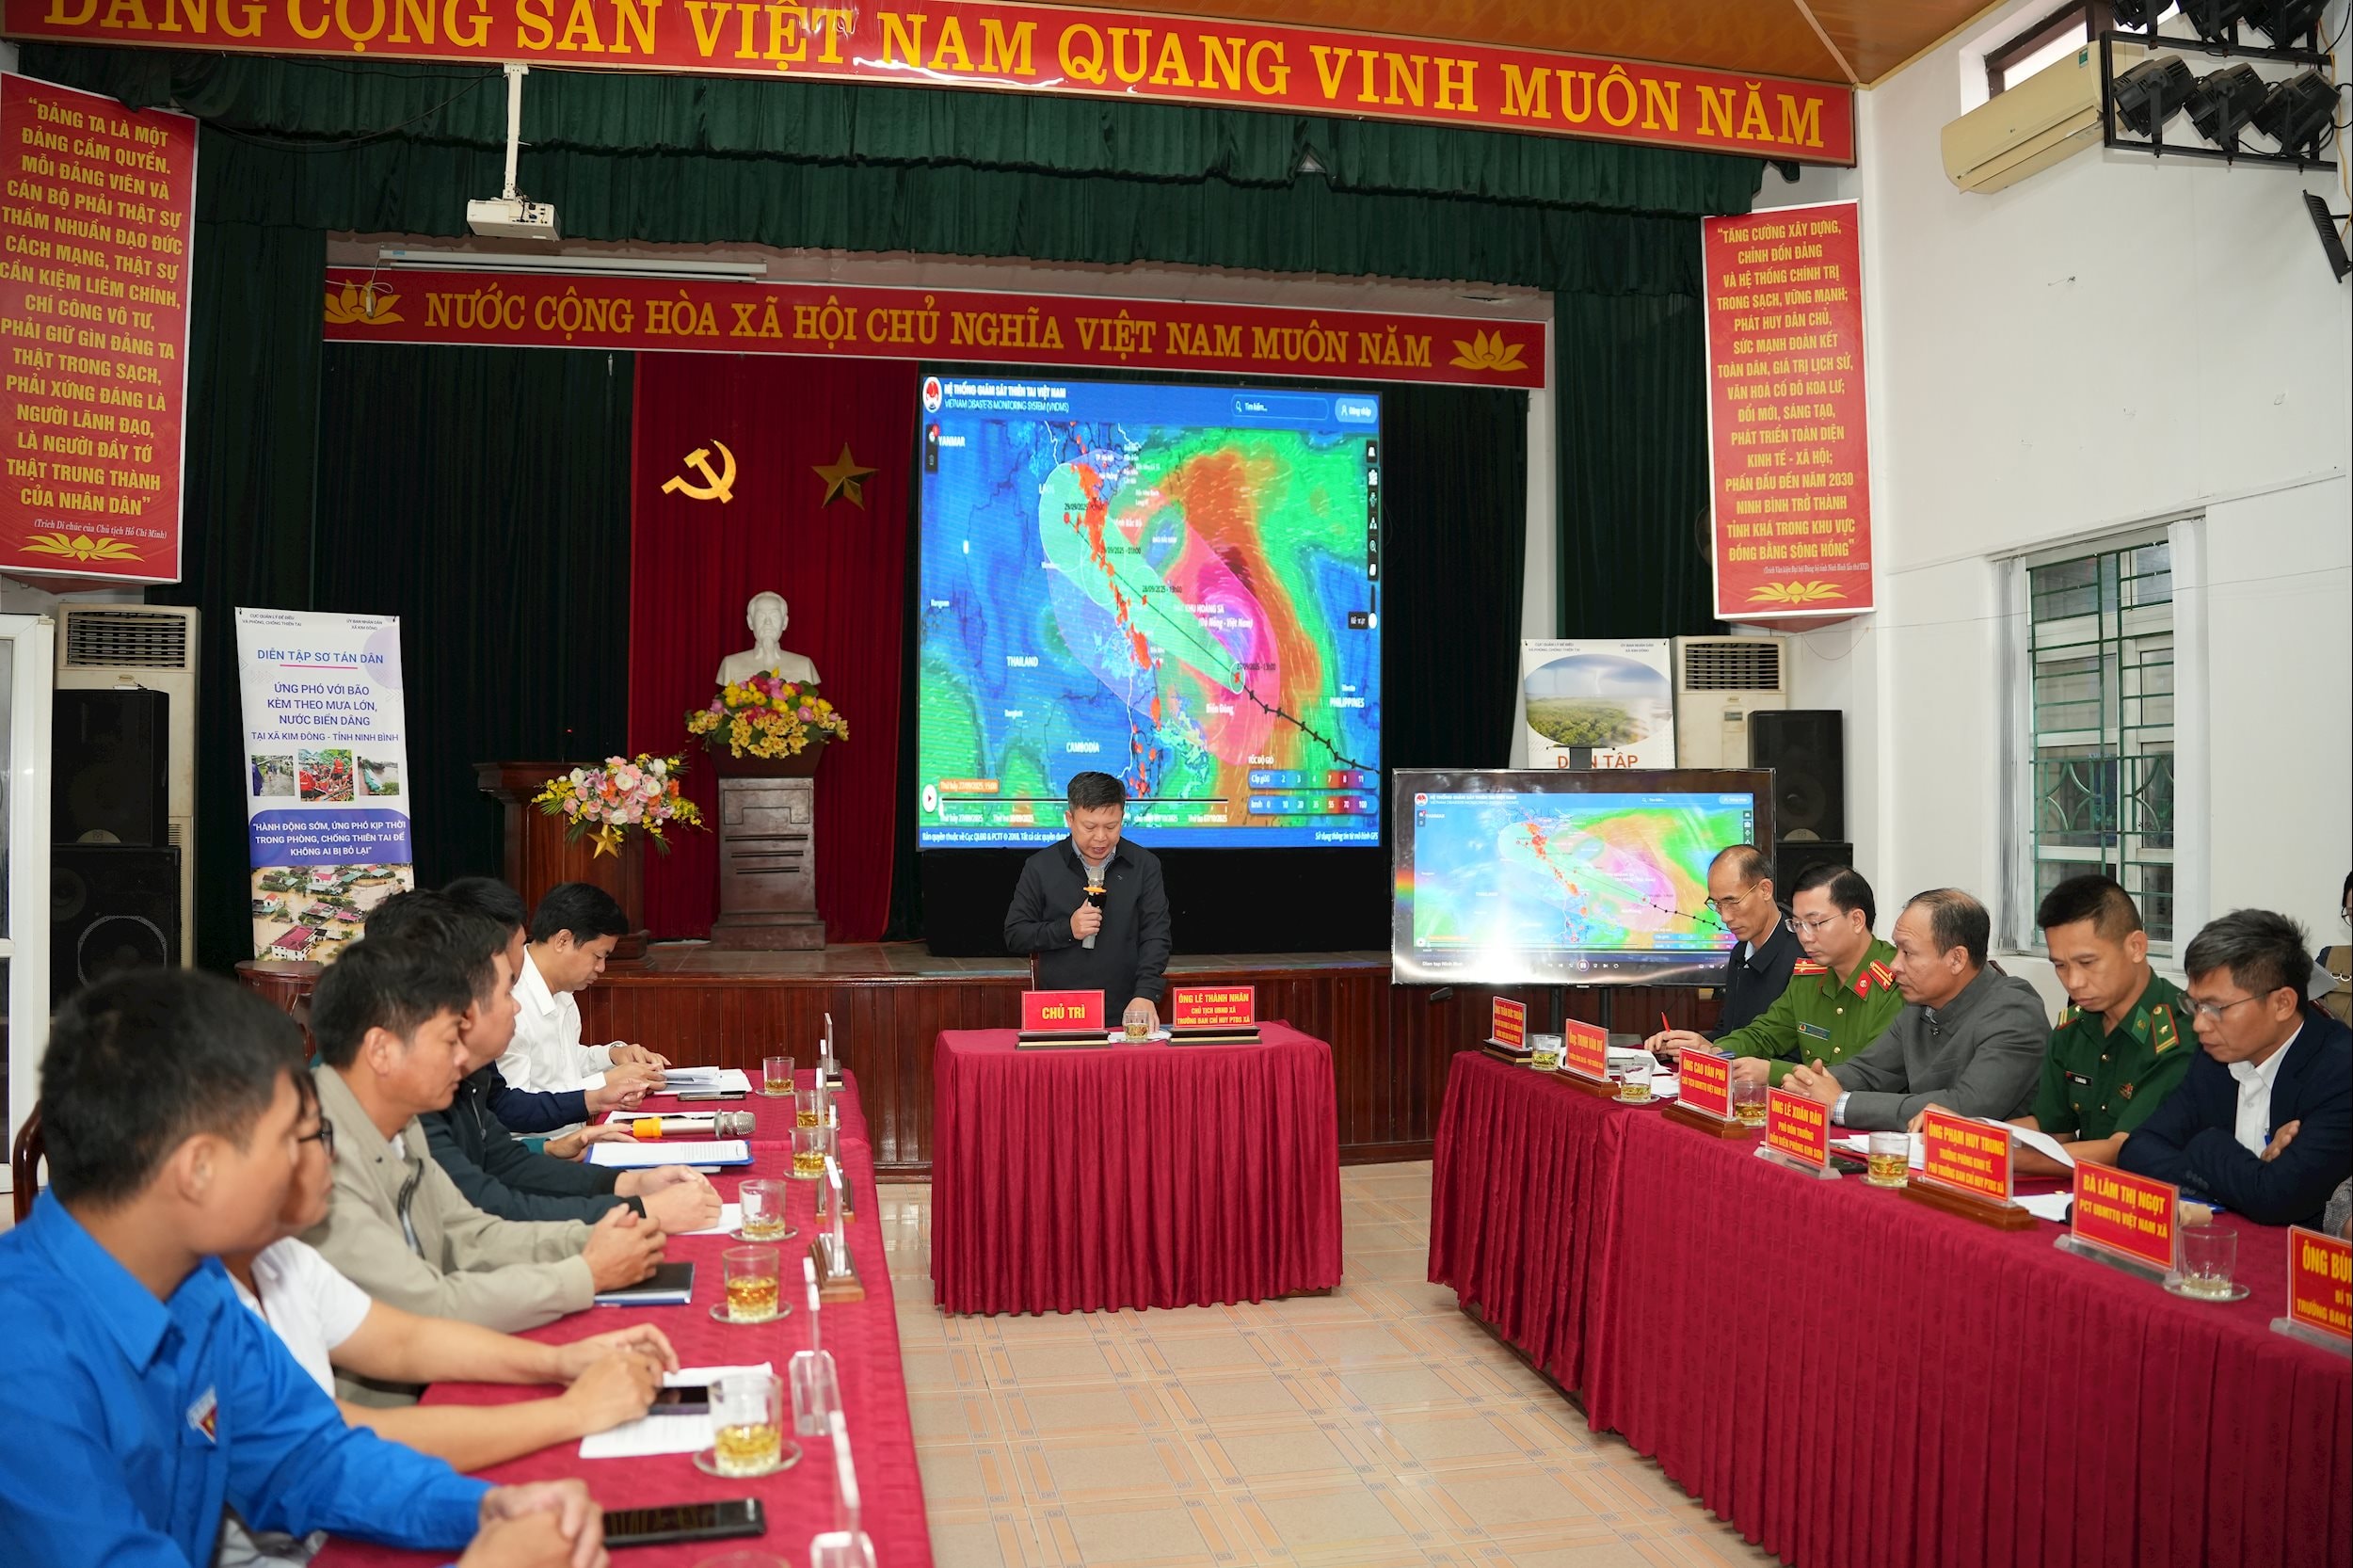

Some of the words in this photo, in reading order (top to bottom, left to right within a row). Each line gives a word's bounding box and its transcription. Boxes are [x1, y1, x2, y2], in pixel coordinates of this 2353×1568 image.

[684, 0, 856, 71] VIỆT
[880, 12, 1037, 76] NAM
[1056, 22, 1290, 96] QUANG
[1309, 44, 1478, 113] VINH
[1500, 64, 1681, 133] MUÔN
[1697, 82, 1824, 148] NĂM
[88, 114, 105, 134] TA
[110, 119, 130, 138] LÀ
[134, 125, 168, 148] MỘT
[7, 179, 41, 201] CÁN
[47, 186, 70, 210] BỘ
[74, 192, 112, 216] PHẢI
[117, 200, 155, 225] THẬT
[159, 210, 182, 232] SỰ
[1751, 223, 1785, 241] CƯỜNG
[1787, 220, 1807, 237] XÂY
[1810, 219, 1841, 237] DỰNG,
[1716, 295, 1750, 311] TRONG
[1752, 292, 1782, 310] SẠCH,
[1784, 288, 1812, 305] VỮNG
[1814, 286, 1848, 305] MẠNH;
[24, 294, 53, 313] CHÍ
[57, 297, 102, 321] CÔNG
[106, 305, 127, 325] VÔ
[131, 311, 154, 331] TƯ,
[424, 282, 525, 329] NƯỚC
[535, 286, 634, 340] CỘNG
[645, 289, 720, 336] HÒA
[729, 296, 783, 338] XÃ
[793, 295, 857, 349] HỘI
[866, 295, 940, 344] CHỦ
[951, 307, 1064, 350] NGHĨA
[1075, 309, 1157, 360] VIỆT
[1167, 325, 1243, 358] NAM
[1252, 319, 1349, 363] MUÔN
[1358, 324, 1433, 368] NĂM
[6, 372, 45, 395] PHẢI
[50, 378, 95, 402] XỨNG
[99, 386, 142, 408] ĐÁNG
[147, 392, 166, 411] LÀ
[944, 399, 968, 408] VIETNAM
[1730, 428, 1756, 445] PHÁT
[1758, 424, 1788, 443] TRIỂN
[1790, 424, 1817, 442] TOÀN
[1819, 423, 1844, 441] DIỆN
[17, 429, 38, 450] LÀ
[42, 434, 92, 456] NGƯỜI
[97, 437, 129, 460] ĐẦY
[133, 443, 152, 463] TỚ
[1724, 472, 1753, 491] PHẤN
[1754, 471, 1776, 490] ĐẤU
[1778, 470, 1800, 488] ĐẾN
[1801, 471, 1826, 488] NĂM
[1828, 472, 1853, 487] 2030
[21, 484, 54, 506] CỦA
[58, 490, 104, 512] NHÂN
[1736, 499, 1762, 514] NINH
[1763, 496, 1788, 513] BÌNH
[1790, 492, 1811, 511] TRỞ
[1812, 493, 1847, 510] THÀNH
[1728, 542, 1757, 561] ĐỒNG
[1758, 540, 1787, 560] BẰNG
[1789, 541, 1817, 558] SÔNG
[257, 647, 284, 660] DIỄN
[287, 648, 312, 663] TẬP
[314, 651, 330, 662] SƠ
[332, 650, 357, 663] TÁN
[360, 651, 383, 664] DÂN
[1006, 656, 1038, 668] THAILAND
[274, 680, 298, 693] ỨNG
[300, 682, 324, 694] PHÓ
[326, 683, 344, 695] VỚI
[347, 683, 369, 696] BÃO
[1330, 696, 1365, 709] PHILIPPINES
[279, 712, 311, 724] NƯỚC
[312, 712, 338, 725] BIỂN
[340, 713, 370, 726] DÂNG
[1065, 741, 1099, 754] CAMBODIA
[1558, 755, 1597, 768] DN
[255, 835, 284, 843] TRONG
[286, 833, 319, 843] PHÒNG,
[320, 832, 350, 842] CHỐNG
[351, 832, 376, 841] THIÊN
[376, 833, 392, 841] TAI
[392, 830, 405, 842] ĐỂ
[1178, 993, 1193, 1003] ÔNG
[1042, 1002, 1064, 1019] CHỦ
[1067, 1003, 1085, 1018] TRÌ
[1929, 1120, 1944, 1140] ÔNG
[1944, 1127, 1964, 1146] PHẠM
[1965, 1132, 1980, 1149] HUY
[1980, 1136, 2005, 1157] TRUNG
[2121, 1185, 2137, 1209] THỊ
[2138, 1191, 2166, 1216] NGỌT
[2137, 1217, 2156, 1235] NAM
[2302, 1240, 2328, 1276] ÔNG
